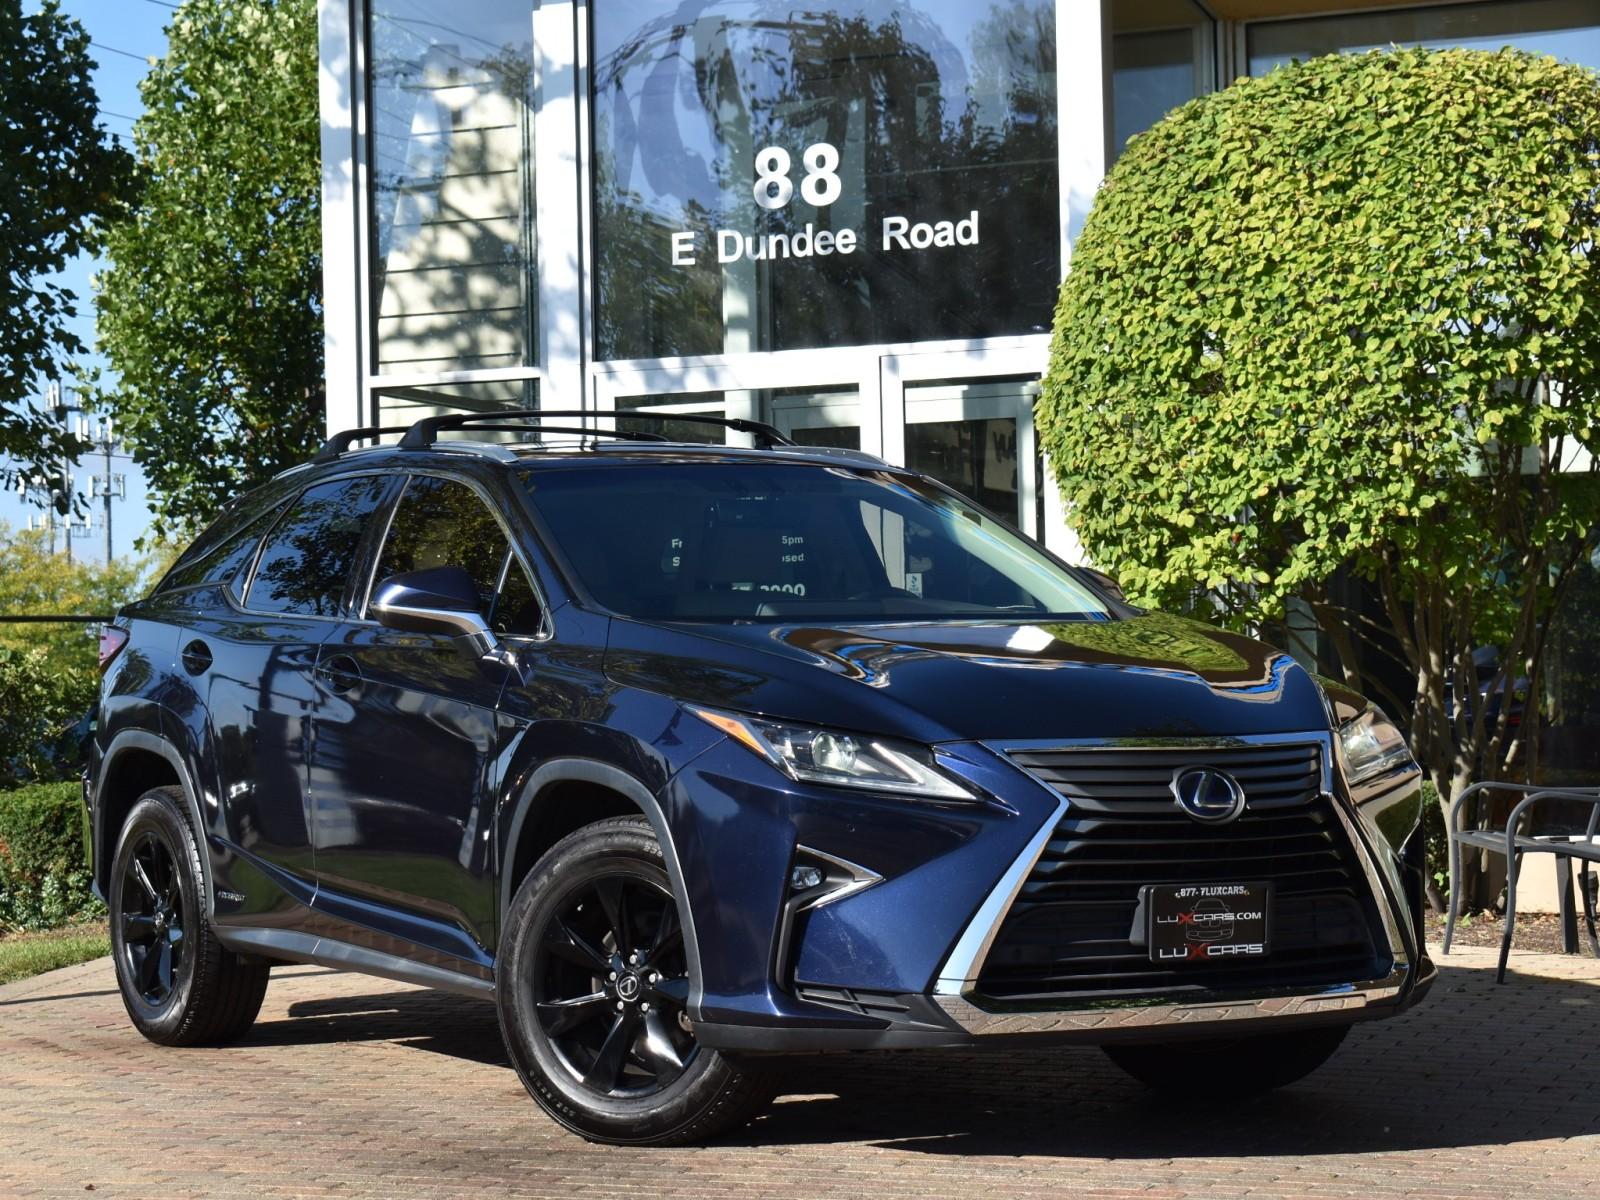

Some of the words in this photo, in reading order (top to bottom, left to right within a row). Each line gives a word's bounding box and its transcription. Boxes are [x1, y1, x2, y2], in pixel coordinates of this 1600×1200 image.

[753, 142, 842, 210] 88
[671, 231, 696, 266] E
[717, 223, 857, 264] Dundee
[882, 210, 979, 251] Road
[781, 535, 804, 547] 5pm
[1159, 942, 1263, 960] LUXCARS
